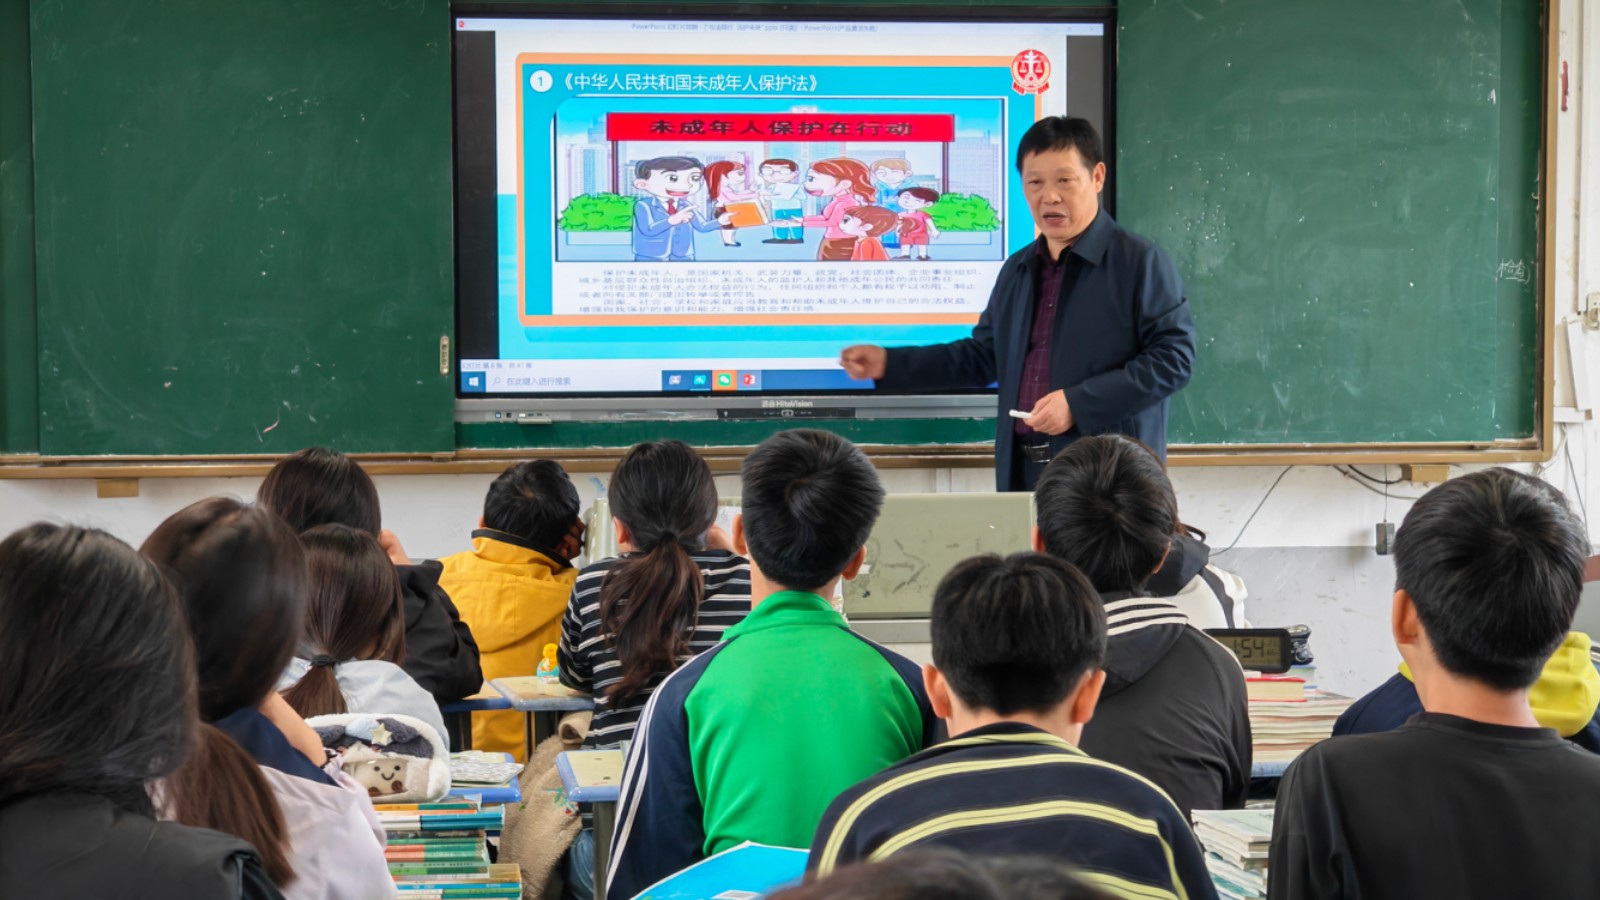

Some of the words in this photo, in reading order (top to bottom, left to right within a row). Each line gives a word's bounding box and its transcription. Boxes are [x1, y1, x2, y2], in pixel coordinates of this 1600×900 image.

[565, 73, 819, 92] 《中华人民共和国未成年人保护法》
[649, 119, 913, 136] 未成年人保护在行动
[506, 377, 571, 386] 在此键入进行搜索
